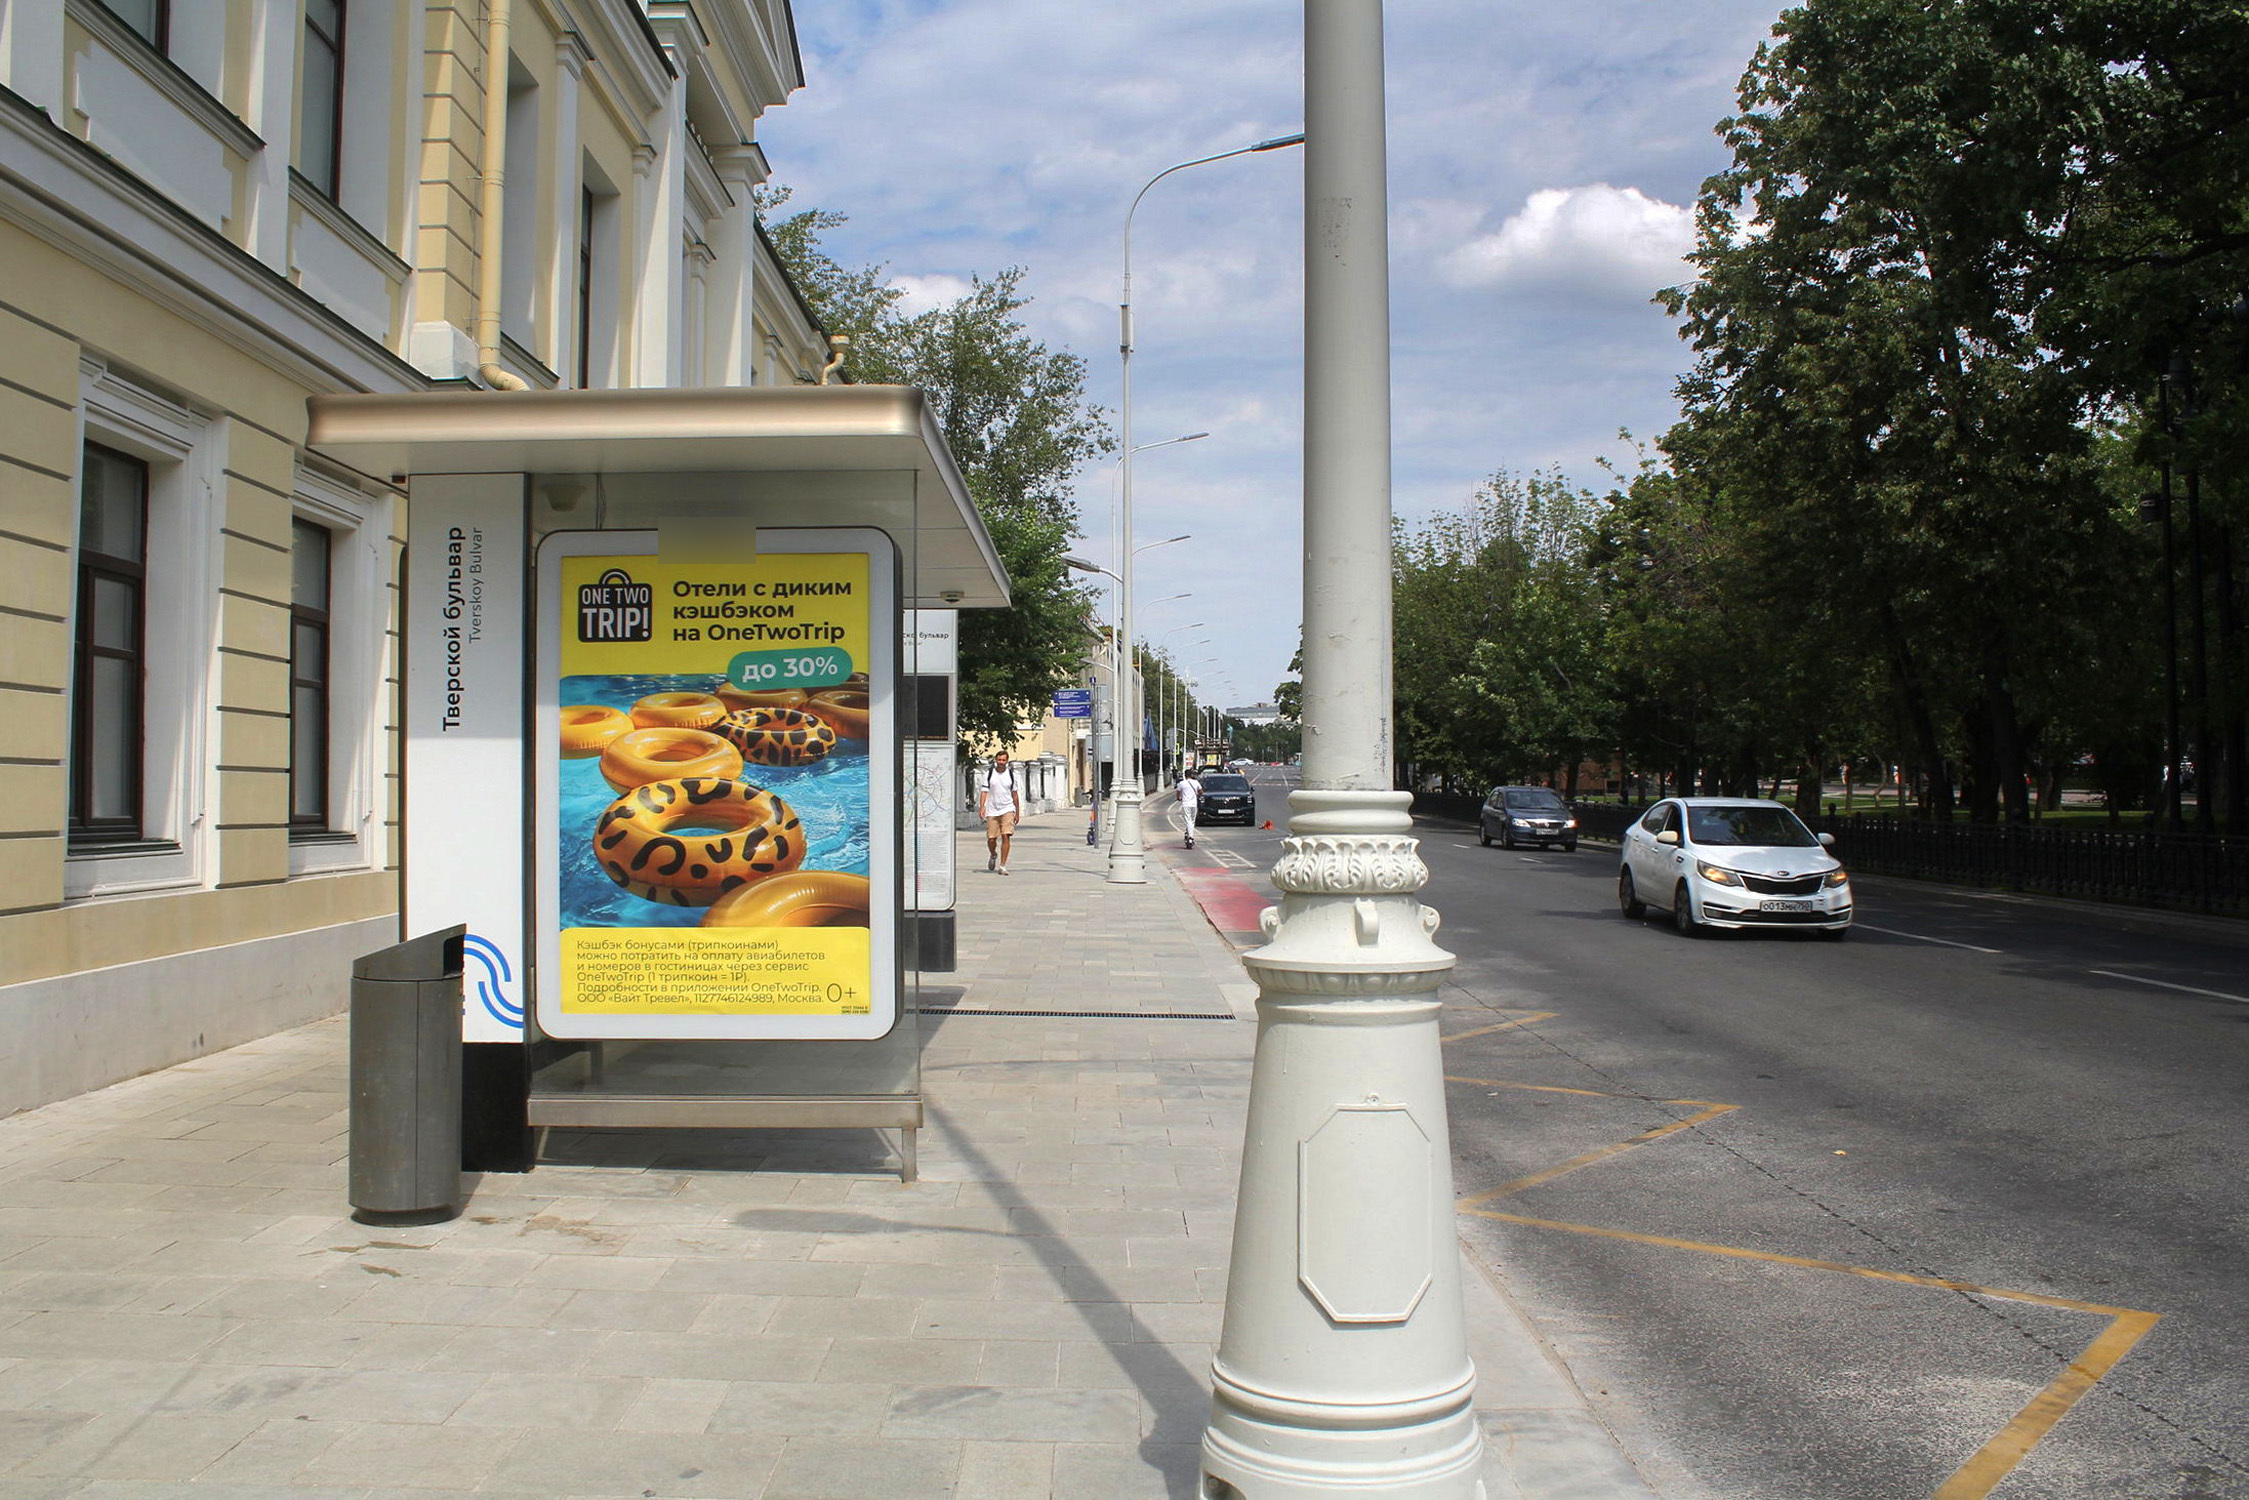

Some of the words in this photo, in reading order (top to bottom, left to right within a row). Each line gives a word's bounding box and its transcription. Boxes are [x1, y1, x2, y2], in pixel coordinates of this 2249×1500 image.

[469, 527, 483, 574] Bulvar
[443, 527, 466, 620] бульвар
[582, 588, 611, 605] ONE
[615, 587, 649, 604] TWO
[673, 581, 746, 597] Отели
[753, 583, 767, 596] с
[772, 582, 851, 598] диким
[469, 579, 484, 644] Tverskoy
[673, 601, 794, 619] кэшбэком
[582, 607, 649, 638] TRIP!
[673, 627, 700, 641] на
[707, 621, 845, 643] OneTwoTrip
[742, 661, 777, 682] до
[783, 656, 838, 679] 30%
[443, 627, 465, 731] Тверской
[577, 940, 622, 950] Кэшбэк
[625, 940, 685, 952] бонусами
[688, 940, 778, 952] (трипкоинами)
[577, 952, 617, 960] можно
[620, 952, 681, 962] потратить
[684, 952, 698, 960] на
[701, 952, 743, 962] оплату
[746, 950, 825, 960] авиабилетов
[588, 963, 641, 972] номеров
[655, 963, 723, 972] гостиницах
[727, 963, 762, 972] через
[765, 963, 809, 972] сервис
[577, 972, 645, 983] OneTwoTrip
[648, 972, 656, 983] (1
[659, 973, 718, 983] трипкоин
[577, 982, 657, 993] Подробности
[661, 984, 668, 992] в
[671, 984, 748, 994] приложении
[751, 982, 822, 993] OneTwoTrip.
[826, 983, 857, 1003] 0+
[577, 993, 606, 1002] ООО
[609, 992, 640, 1002] «Вайт
[643, 993, 692, 1004] Тревел»,
[695, 993, 775, 1004] 1127746124989,
[778, 993, 824, 1003] Москва.
